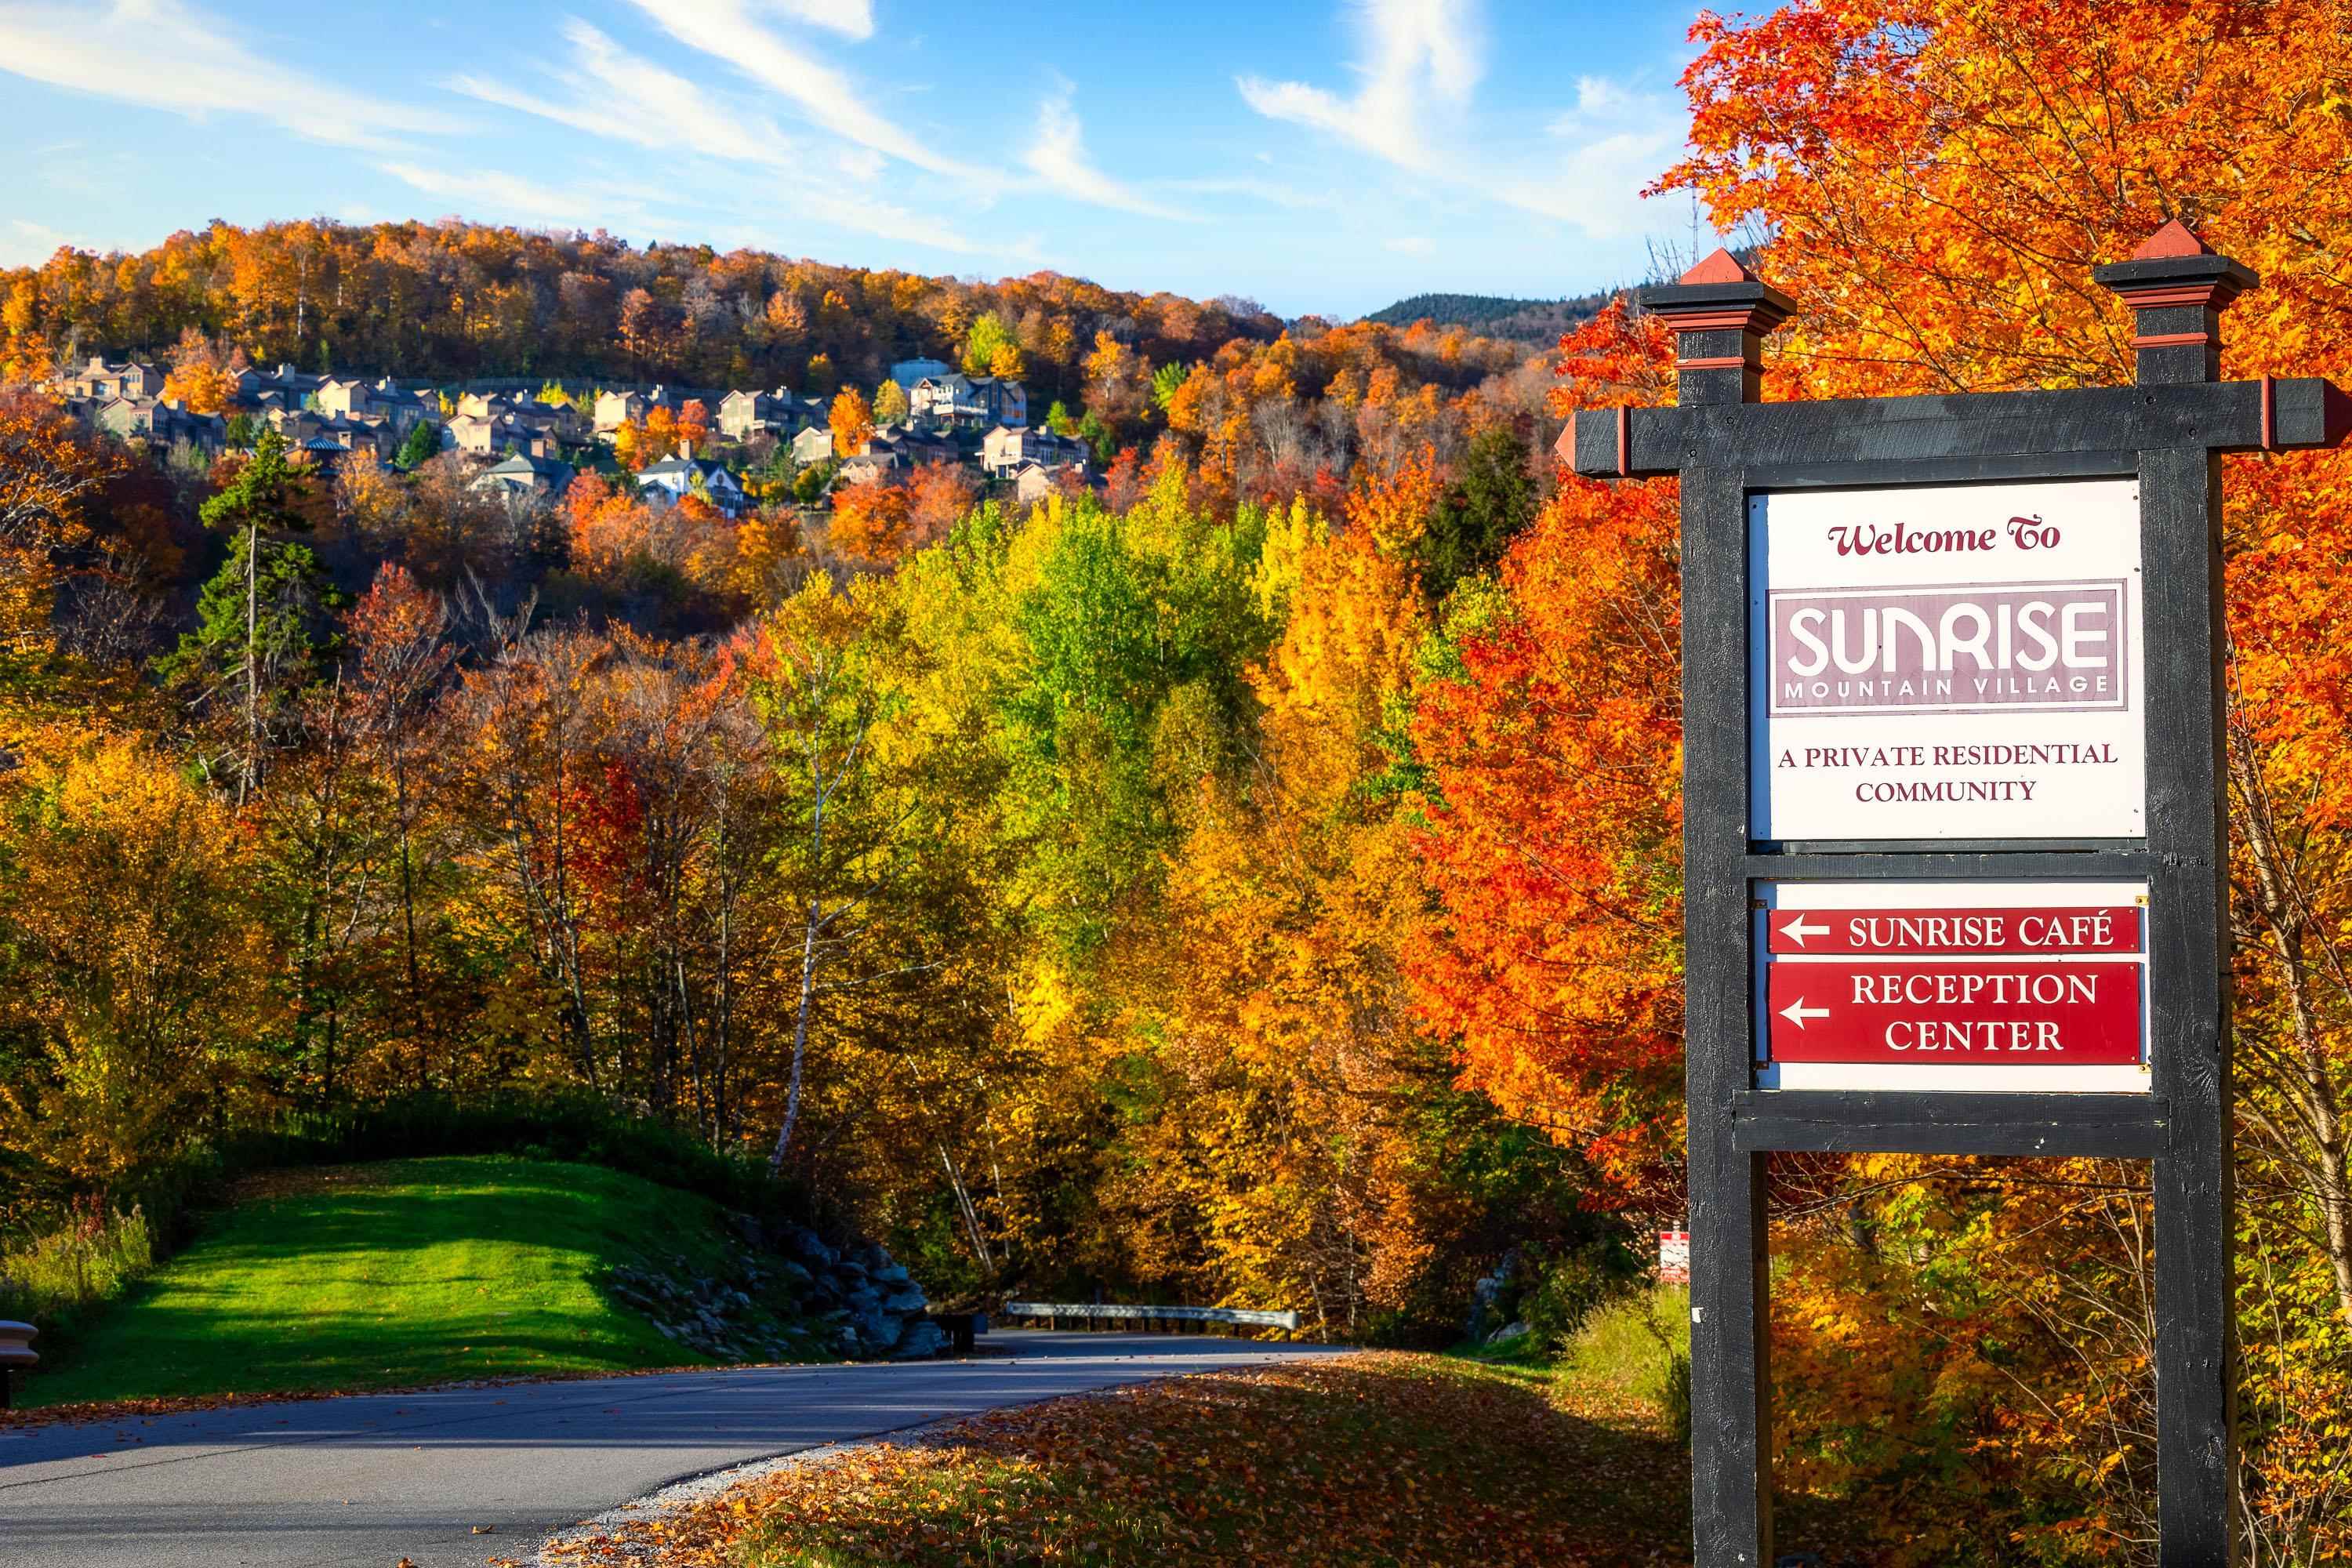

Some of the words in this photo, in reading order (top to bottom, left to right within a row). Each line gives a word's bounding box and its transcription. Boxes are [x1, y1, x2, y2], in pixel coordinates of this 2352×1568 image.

[1828, 523, 1996, 556] Welcome
[2007, 514, 2060, 550] To
[1788, 601, 2107, 677] SUNRISE
[1785, 678, 1951, 698] MOUNTAIN
[1974, 676, 2107, 694] VILLAGE
[1778, 749, 1797, 768] A
[1806, 747, 1925, 767] PRIVATE
[1933, 744, 2118, 765] RESIDENTIAL
[1857, 781, 2036, 802] COMMUNITY
[1849, 917, 2005, 946] SUNRISE
[2019, 909, 2114, 946] CAFÉ
[1851, 975, 2098, 1004] RECEPTION
[1886, 1022, 2063, 1050] CENTER
